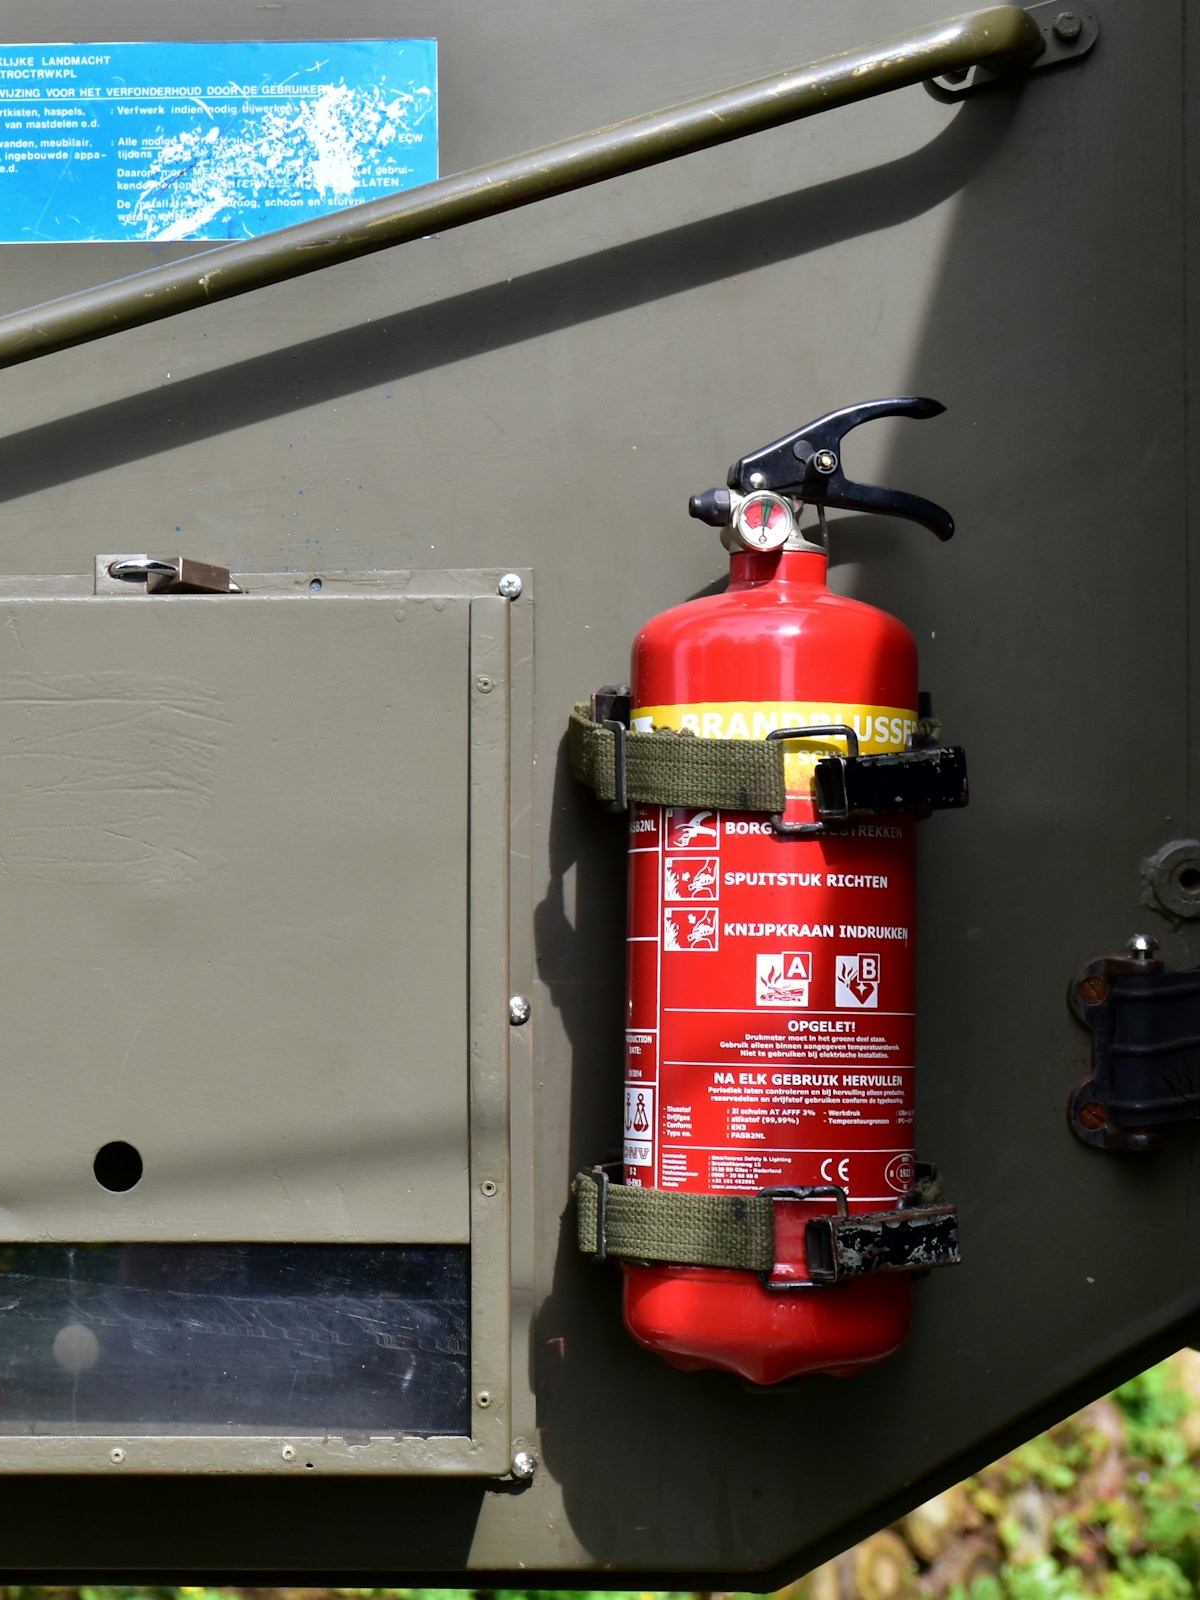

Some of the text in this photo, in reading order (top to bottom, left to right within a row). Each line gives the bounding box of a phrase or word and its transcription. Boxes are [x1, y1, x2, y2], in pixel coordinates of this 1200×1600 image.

[42, 56, 111, 65] LANDMACHT
[46, 88, 75, 97] VOOR
[80, 88, 101, 97] HET
[106, 87, 202, 97] VERFONDERHOUD
[207, 87, 237, 95] DOOR
[244, 86, 257, 95] DE
[44, 107, 85, 117] haspels,
[117, 106, 165, 114] Verfwerk
[26, 120, 78, 129] mastdelen
[81, 119, 100, 128] e.d.
[41, 138, 92, 148] meubilair,
[118, 138, 137, 146] Alle
[5, 151, 68, 162] ingebouwde
[118, 150, 152, 161] tijdens
[0, 165, 18, 173] e.d.
[117, 200, 131, 208] De
[724, 872, 888, 888] SPUITSTUK RICHTEN
[724, 924, 908, 940] KNIJPKRAAN INDRUKKEN
[787, 957, 807, 977] A
[863, 959, 876, 979] B
[788, 1021, 855, 1032] OPGELET!
[832, 1036, 855, 1044] groene
[808, 1051, 818, 1059] bij
[714, 1073, 902, 1086] NA ELK GEBRUIK HERVULLEN
[765, 1087, 810, 1095] controleren
[822, 1089, 831, 1097] bij
[833, 1089, 865, 1097] hervulling
[772, 1096, 803, 1104] drijfstof
[820, 1158, 849, 1181] CE
